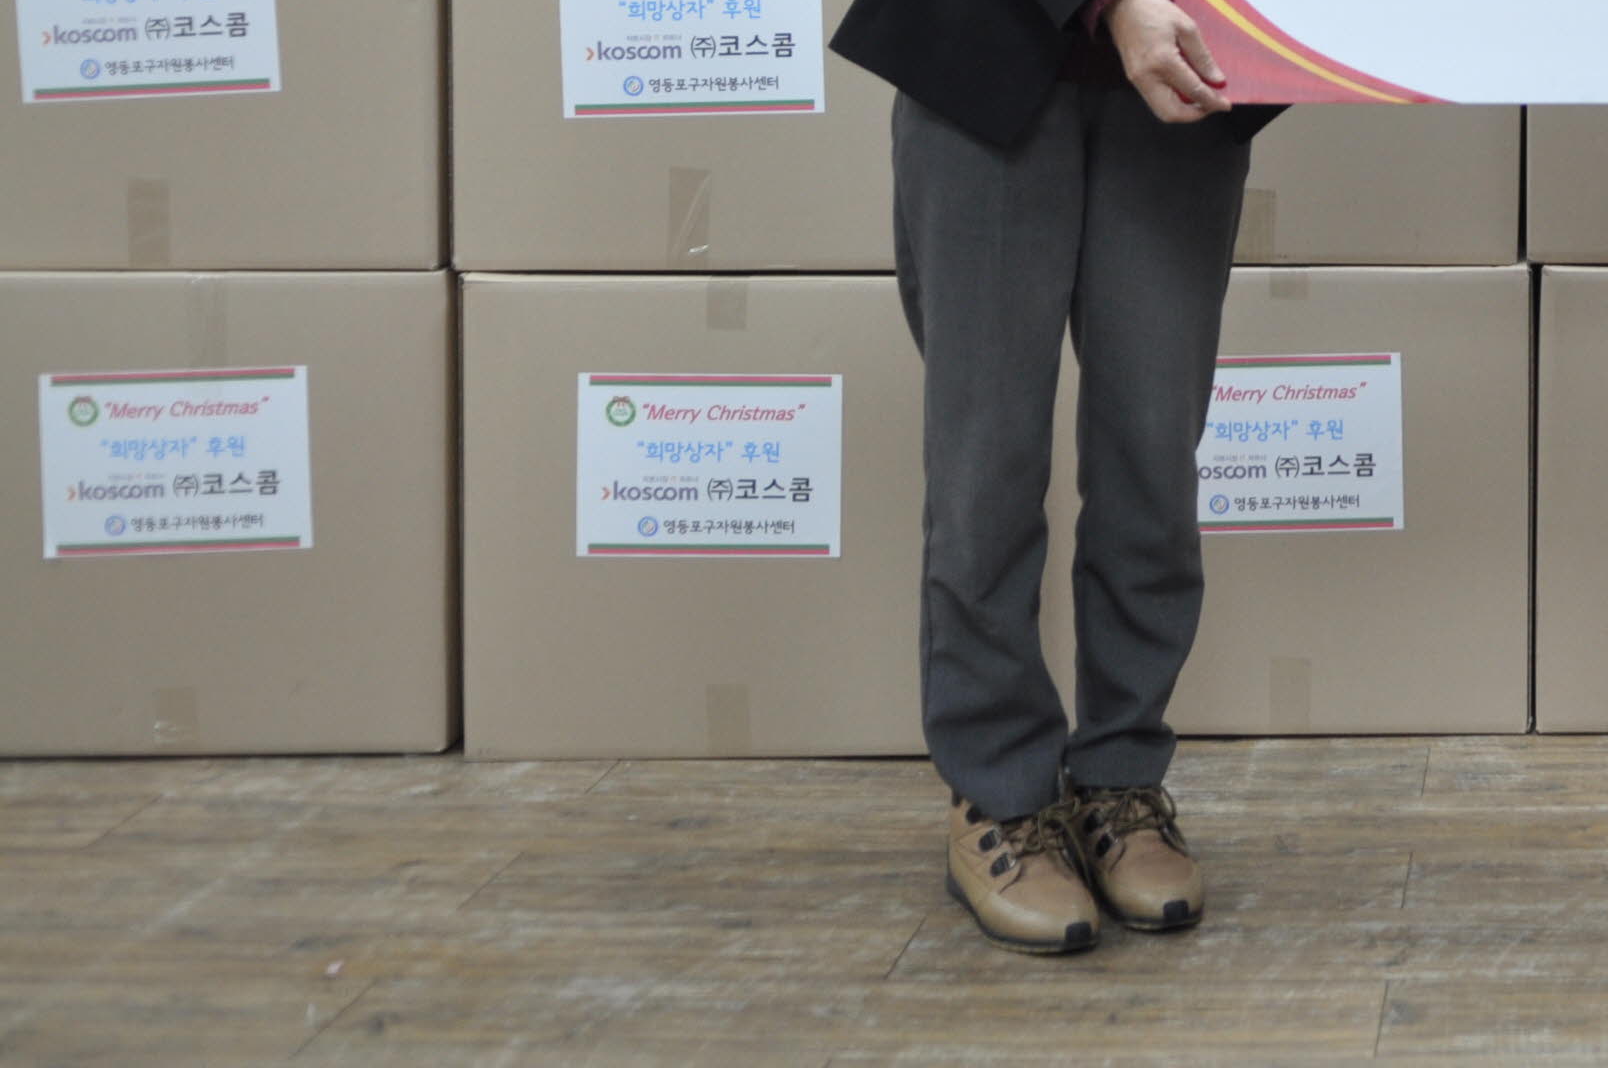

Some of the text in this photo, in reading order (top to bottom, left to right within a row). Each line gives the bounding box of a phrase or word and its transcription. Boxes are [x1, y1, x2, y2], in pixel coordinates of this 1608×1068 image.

[53, 25, 137, 44] koscom
[597, 40, 682, 61] koscom
[104, 55, 235, 76] 영등포구자원봉사센터
[648, 76, 779, 93] 영등포구자원봉사센터
[1306, 419, 1344, 441] 후원
[206, 435, 247, 458] 후원
[741, 441, 780, 463] 후원
[1198, 464, 1267, 480] oscom
[78, 481, 165, 501] koscom
[613, 480, 699, 501] koscom
[1234, 494, 1360, 511] 영등포구자원봉사센터
[663, 519, 795, 535] 영등포구자원봉사센터
